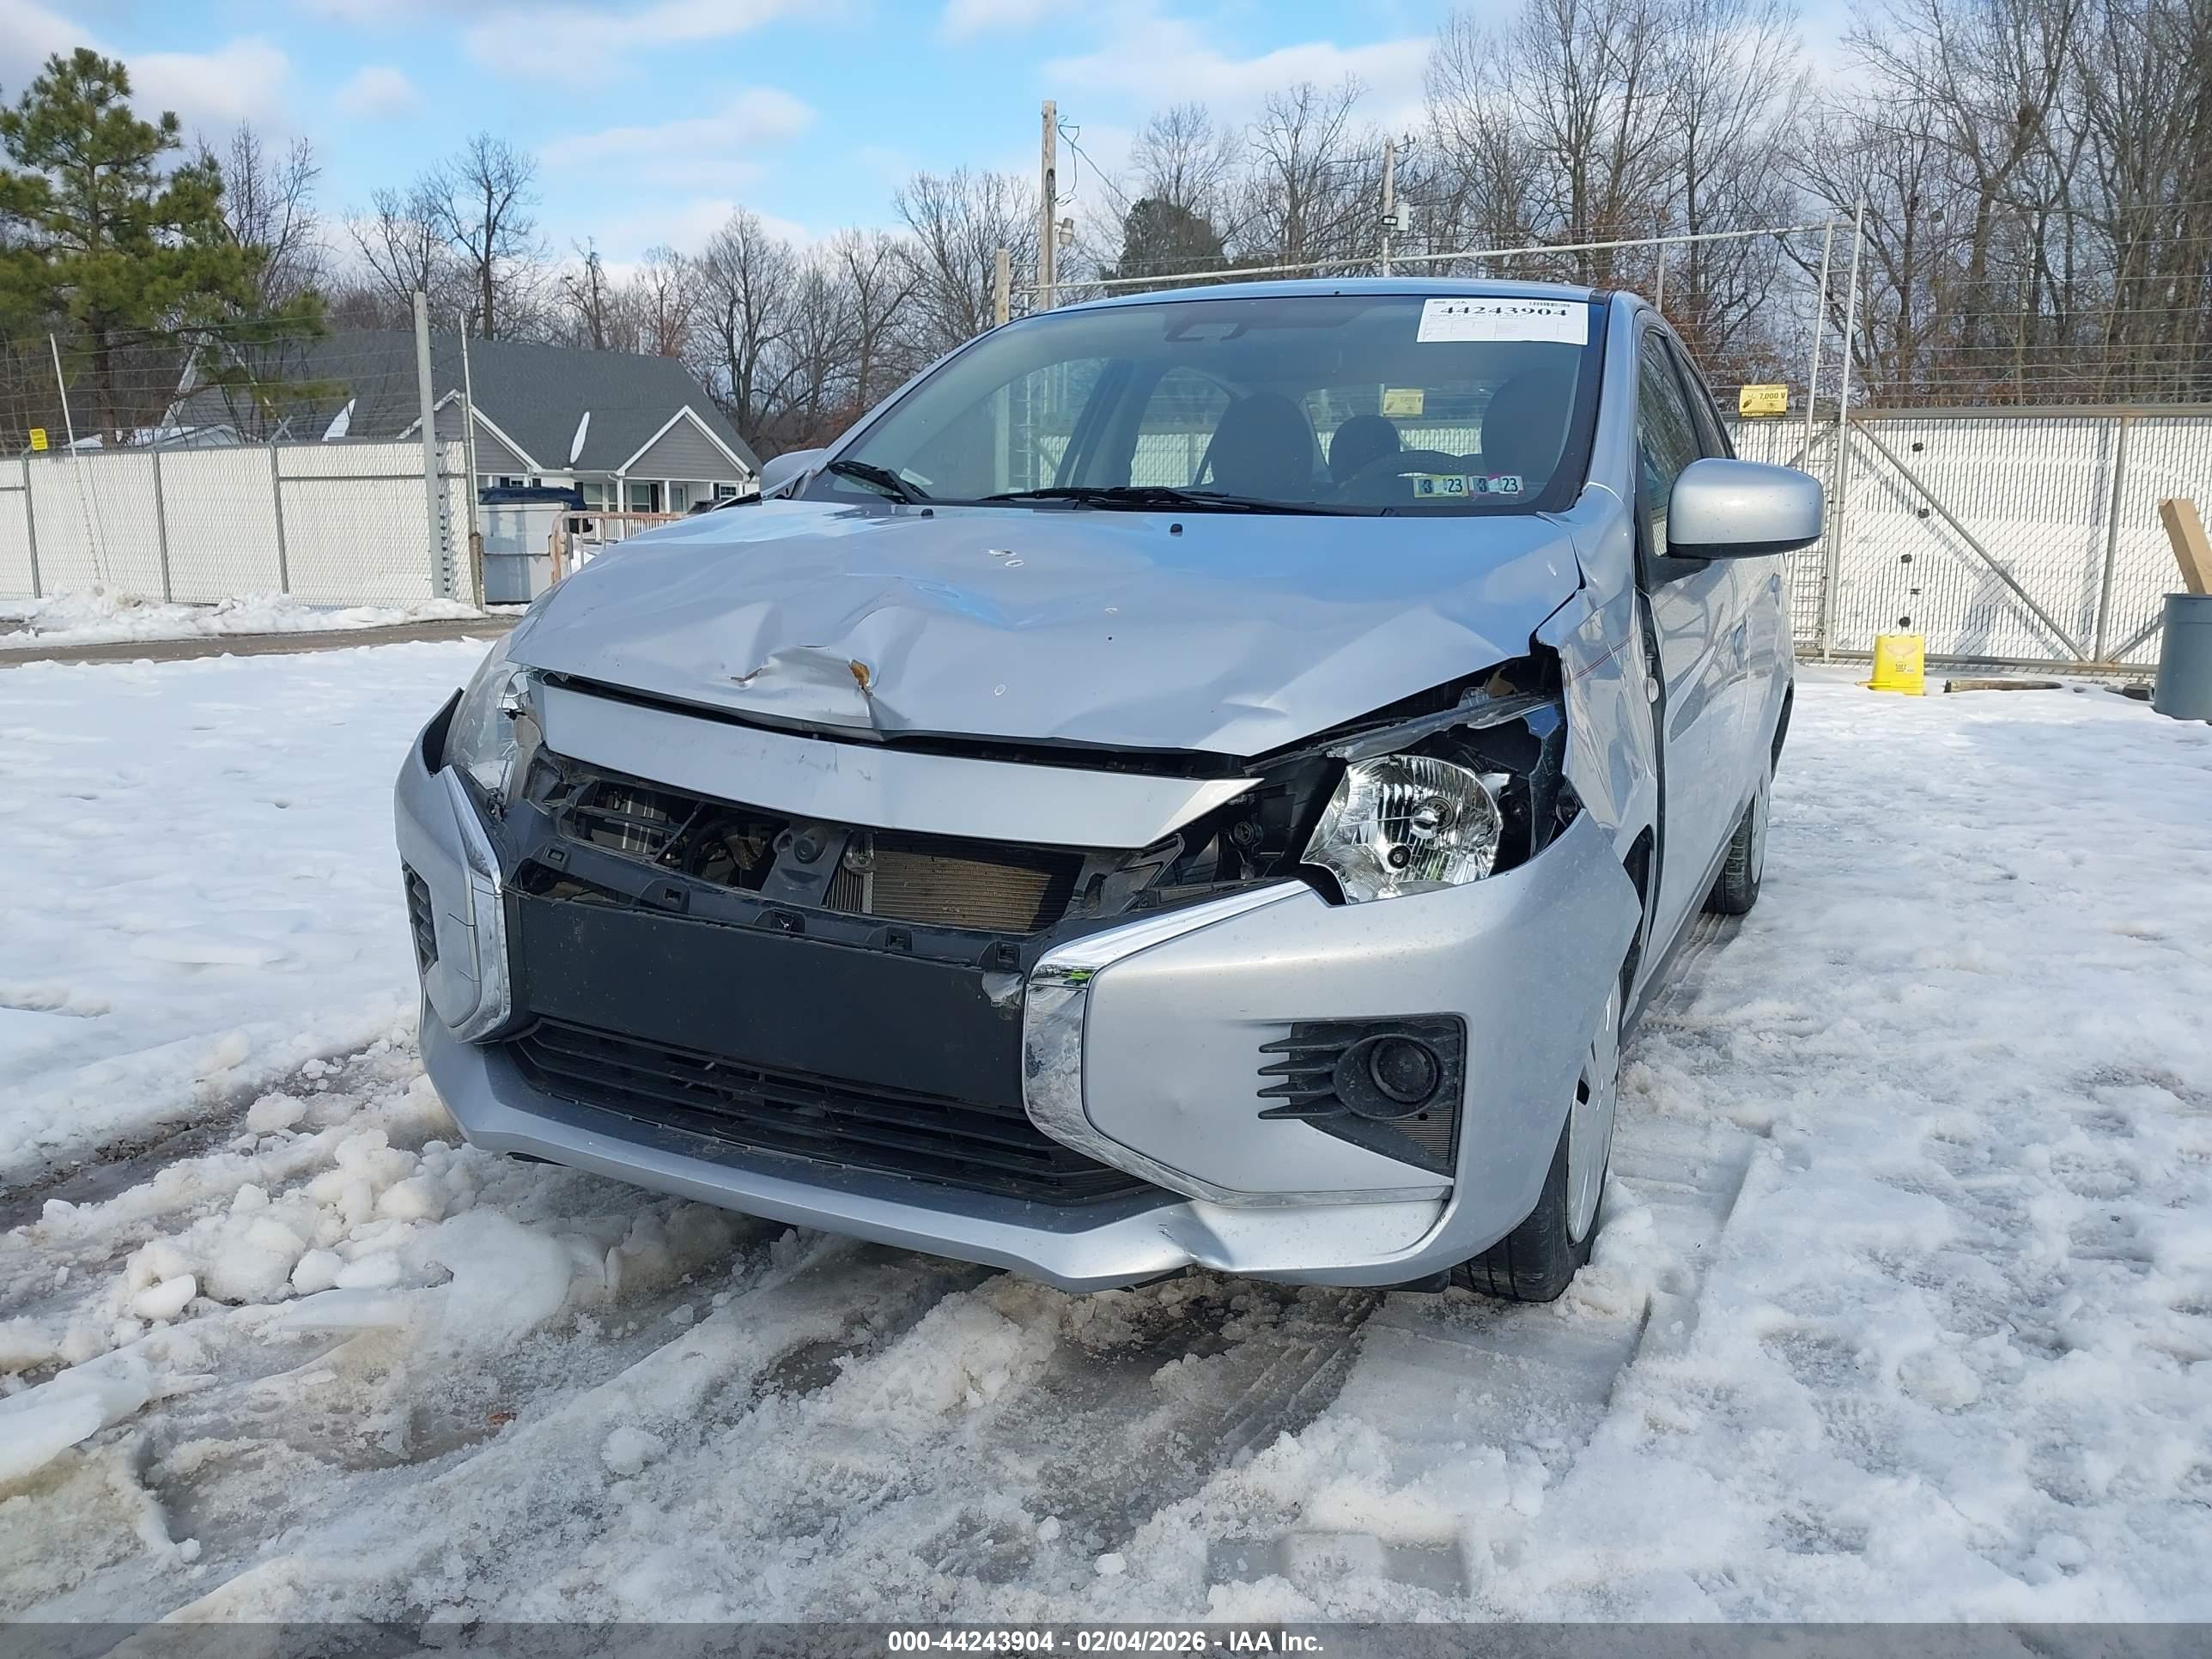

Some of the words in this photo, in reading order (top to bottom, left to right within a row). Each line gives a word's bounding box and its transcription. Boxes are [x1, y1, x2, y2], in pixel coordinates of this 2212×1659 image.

[1440, 306, 1567, 317] 44243904
[1759, 392, 1779, 401] 7,000
[1447, 478, 1463, 493] 23
[1502, 477, 1518, 492] 23
